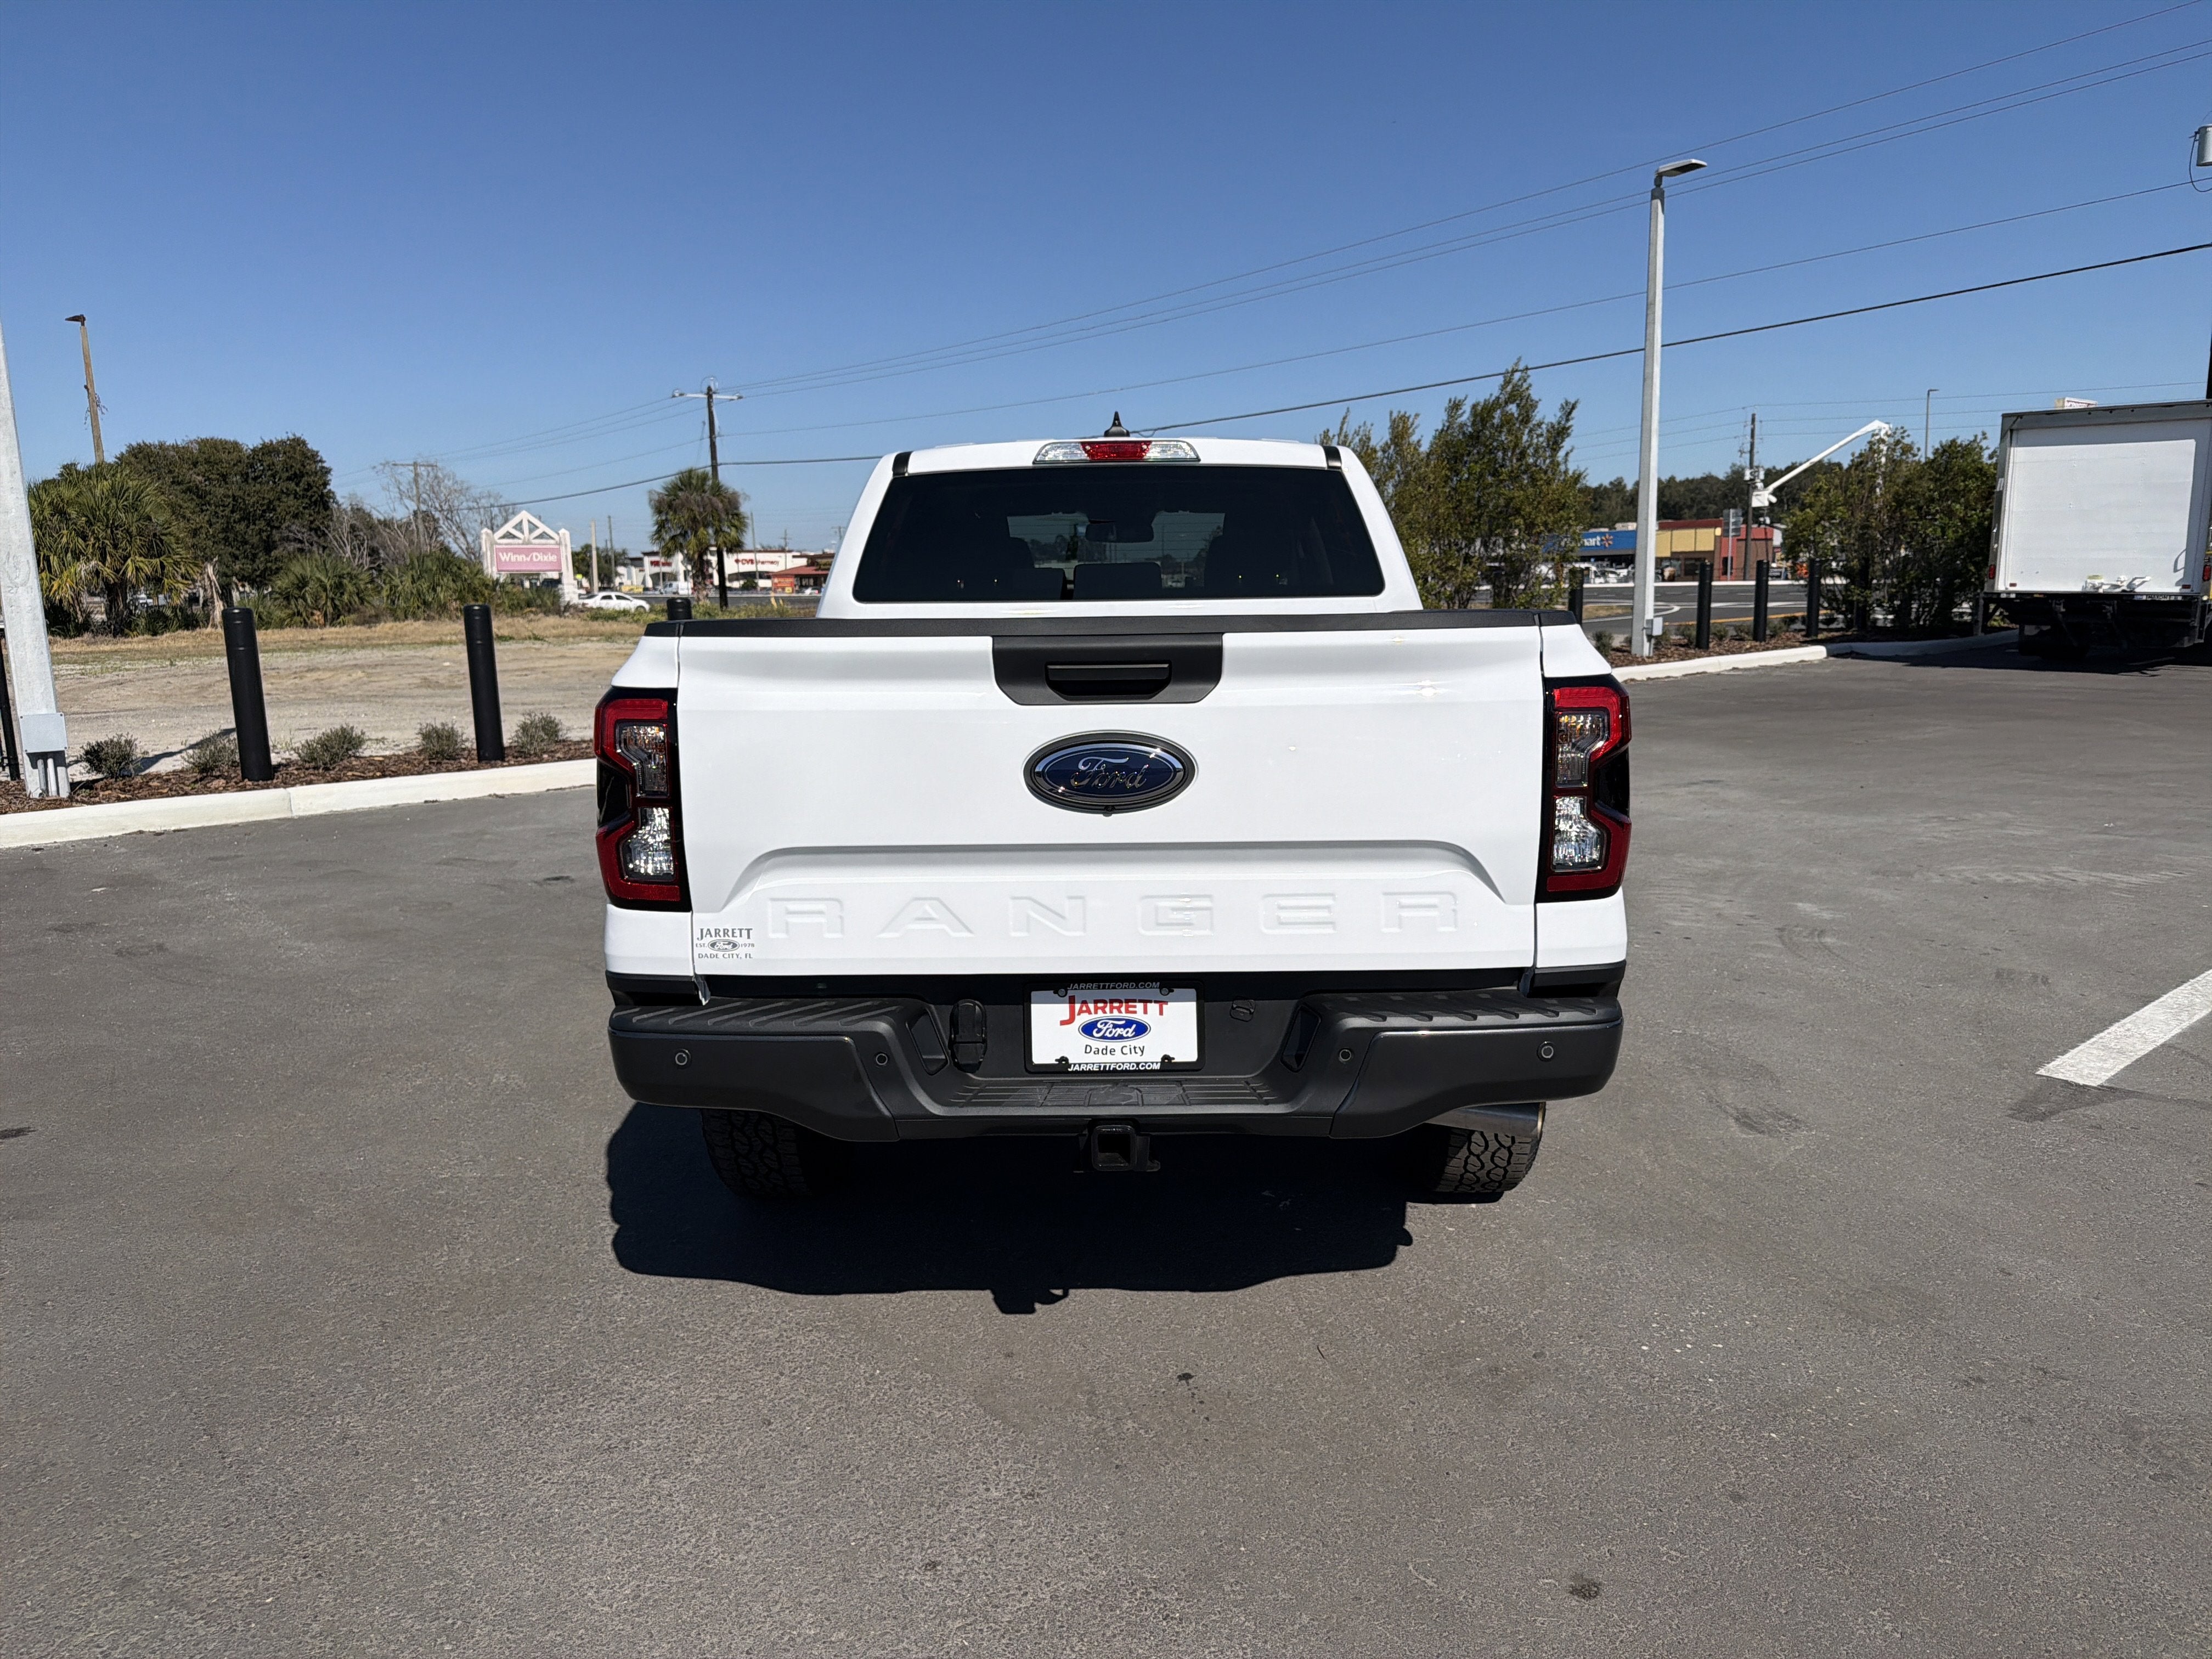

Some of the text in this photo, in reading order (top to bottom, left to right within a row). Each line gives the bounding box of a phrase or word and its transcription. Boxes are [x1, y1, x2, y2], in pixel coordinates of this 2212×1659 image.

[1070, 757, 1150, 788] Ford
[768, 891, 1458, 938] RANGER
[697, 928, 753, 941] JARRETT
[714, 941, 733, 950] Ford
[1068, 981, 1160, 990] JARRETTFORD.COM
[1059, 995, 1169, 1026] JARRETT
[1092, 1019, 1136, 1038] Ford
[1084, 1045, 1145, 1056] Dade City
[1068, 1062, 1161, 1071] JARRETTFORD.COM
